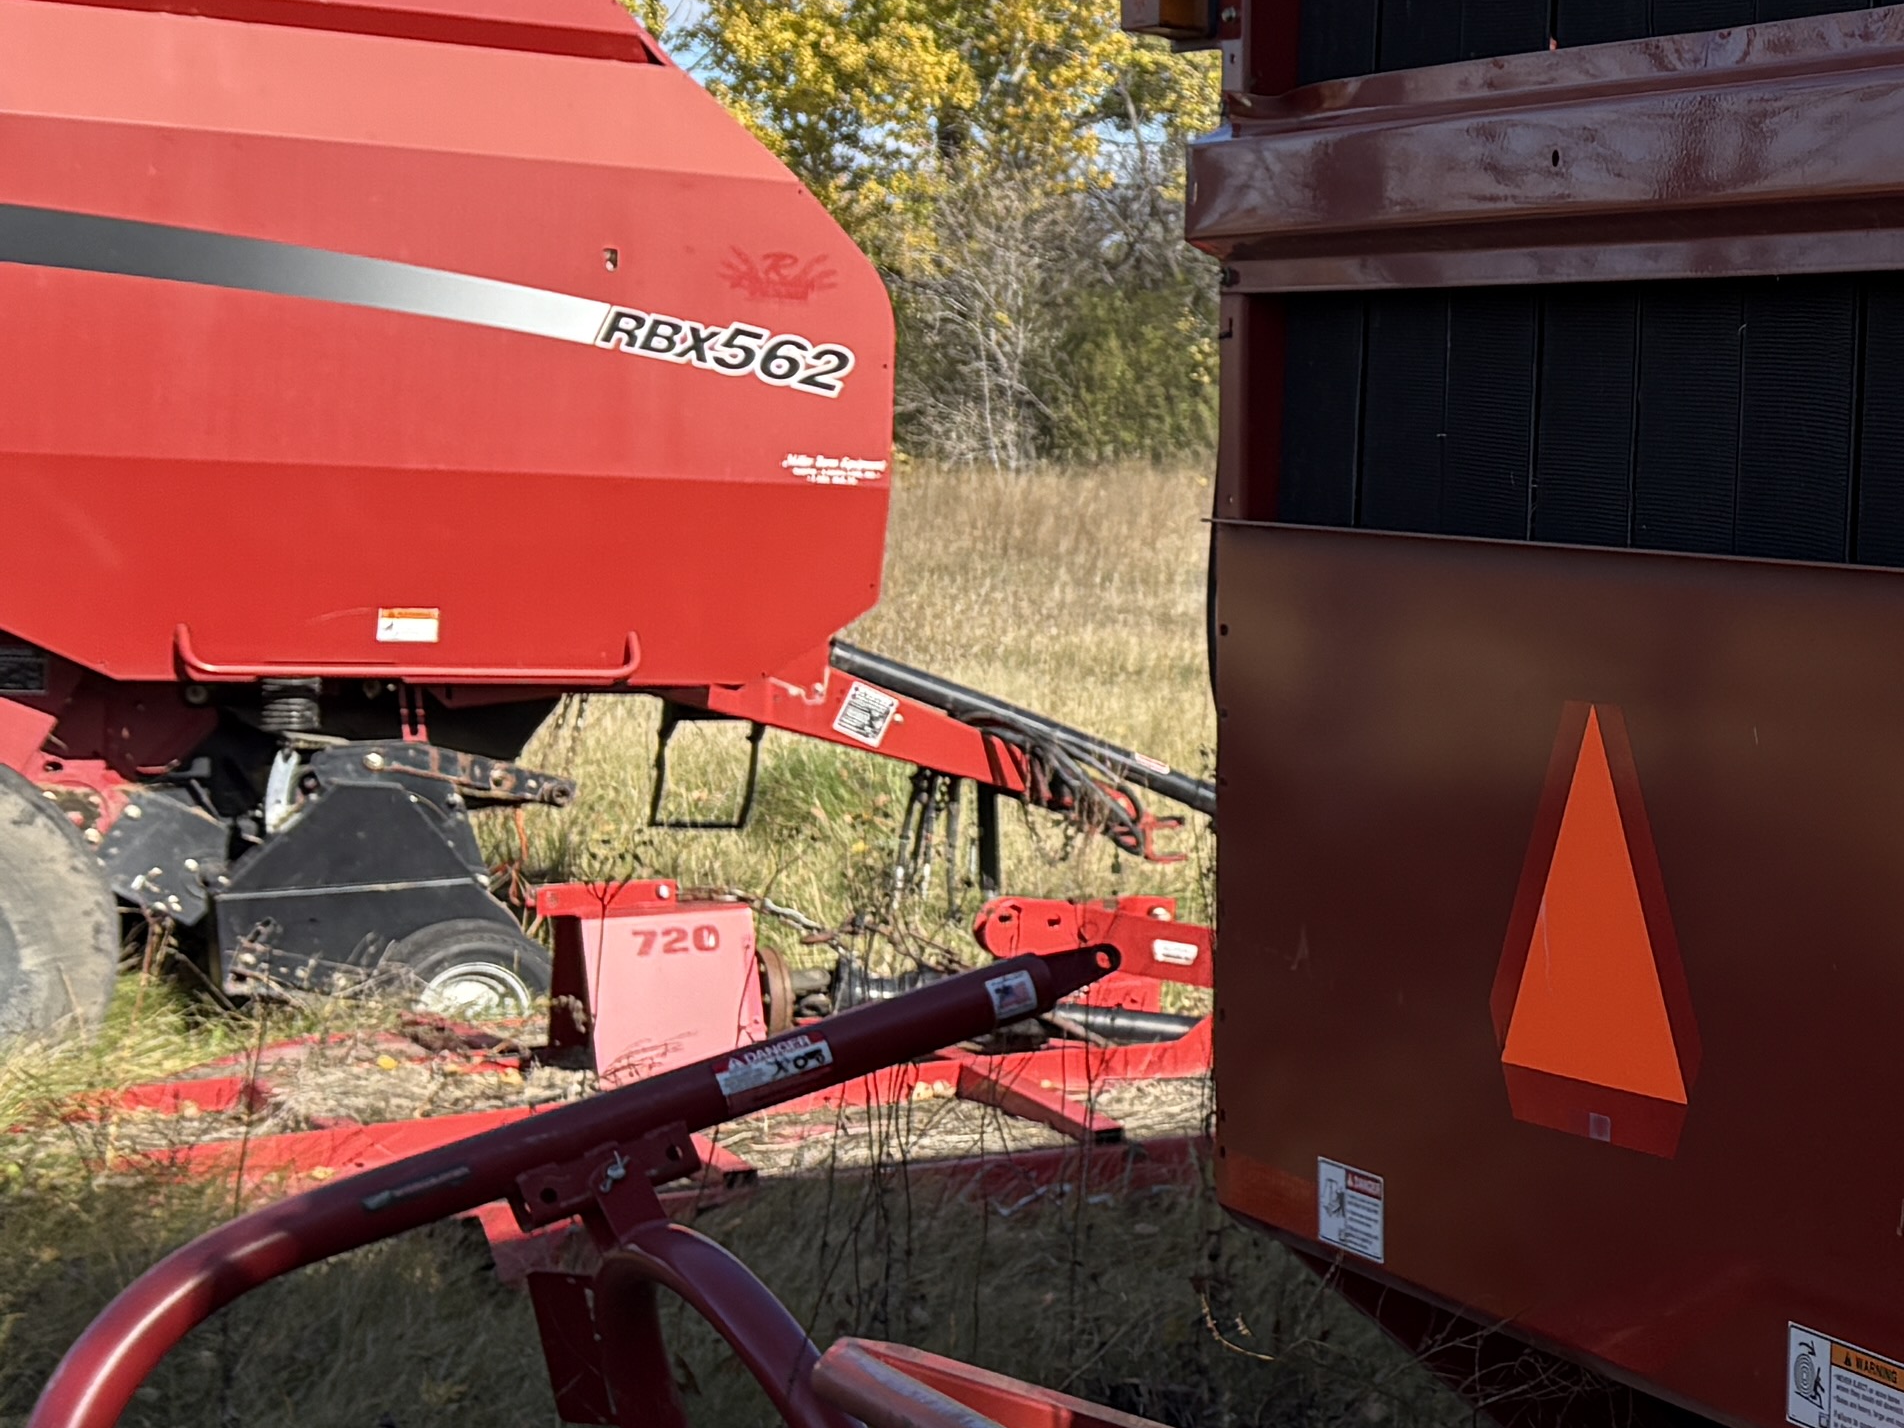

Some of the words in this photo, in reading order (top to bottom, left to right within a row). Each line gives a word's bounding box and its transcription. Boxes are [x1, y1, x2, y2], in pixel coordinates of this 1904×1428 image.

[600, 311, 850, 392] RBX562
[631, 924, 720, 957] 720
[744, 1035, 812, 1064] DANGER
[1856, 1356, 1897, 1384] WARNING
